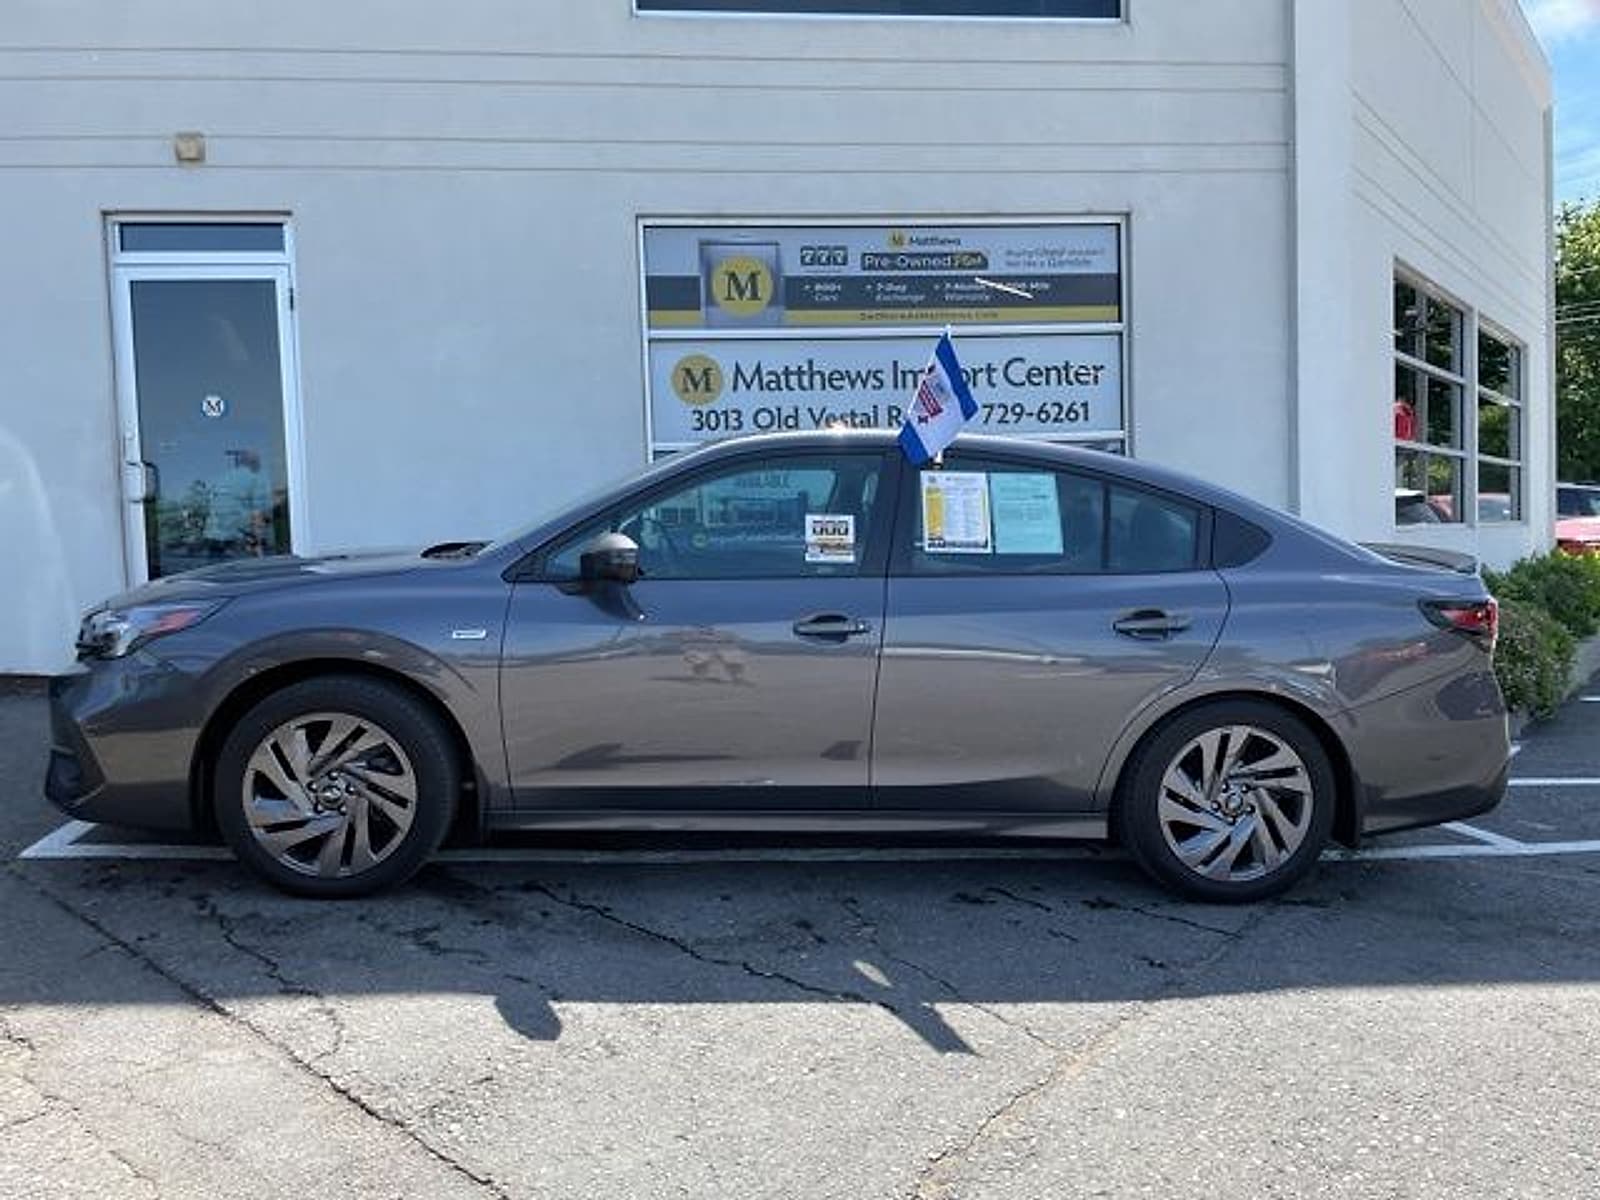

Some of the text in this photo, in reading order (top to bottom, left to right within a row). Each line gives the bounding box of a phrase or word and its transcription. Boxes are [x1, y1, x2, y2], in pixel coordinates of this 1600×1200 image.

[724, 271, 761, 301] M
[681, 367, 713, 393] M
[732, 359, 885, 392] Matthews
[1002, 357, 1105, 388] Center
[692, 409, 744, 432] 3013
[753, 405, 800, 431] Old
[981, 401, 1090, 425] 729-6261
